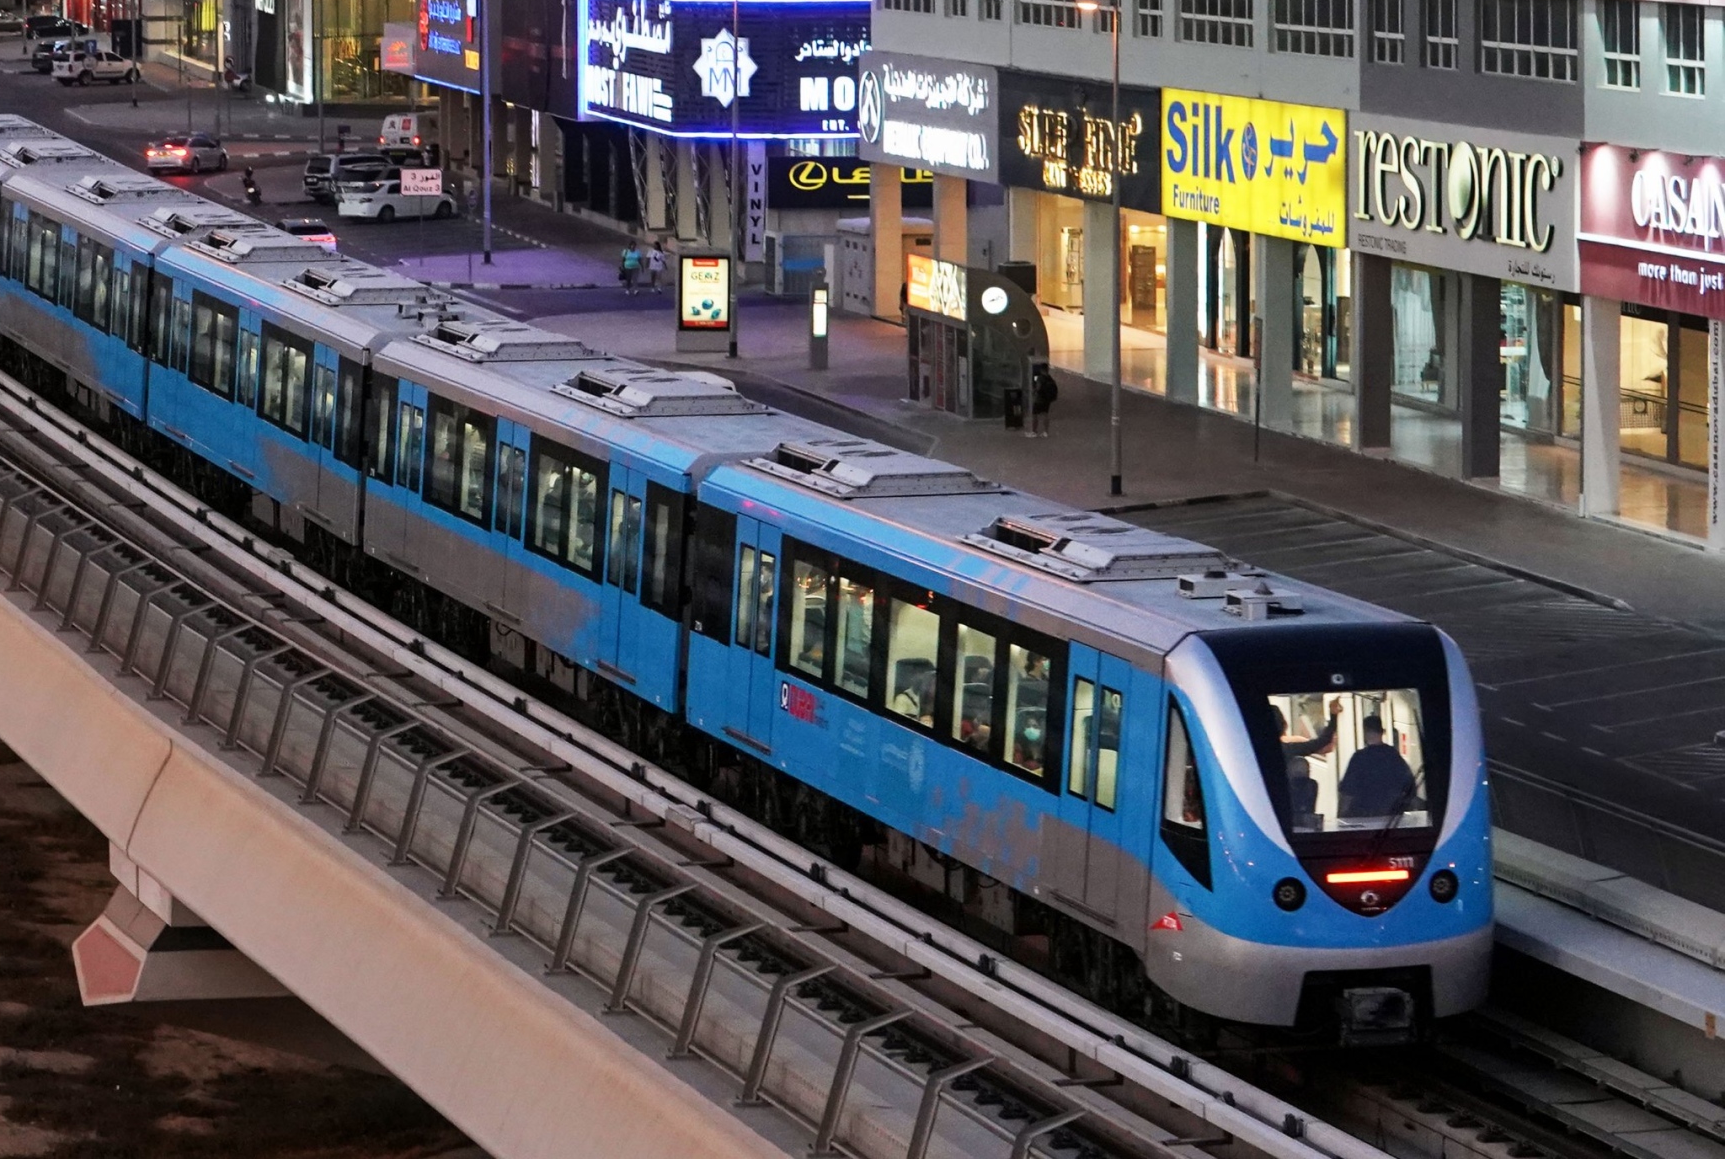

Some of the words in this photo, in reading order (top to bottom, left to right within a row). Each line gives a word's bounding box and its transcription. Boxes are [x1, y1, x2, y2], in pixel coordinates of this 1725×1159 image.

[1166, 101, 1236, 185] Silk
[1264, 117, 1339, 185] حرير
[750, 163, 765, 246] VINYL
[1173, 183, 1220, 215] Furniture
[1638, 261, 1668, 281] more
[1670, 262, 1698, 286] than
[1699, 266, 1724, 295] just
